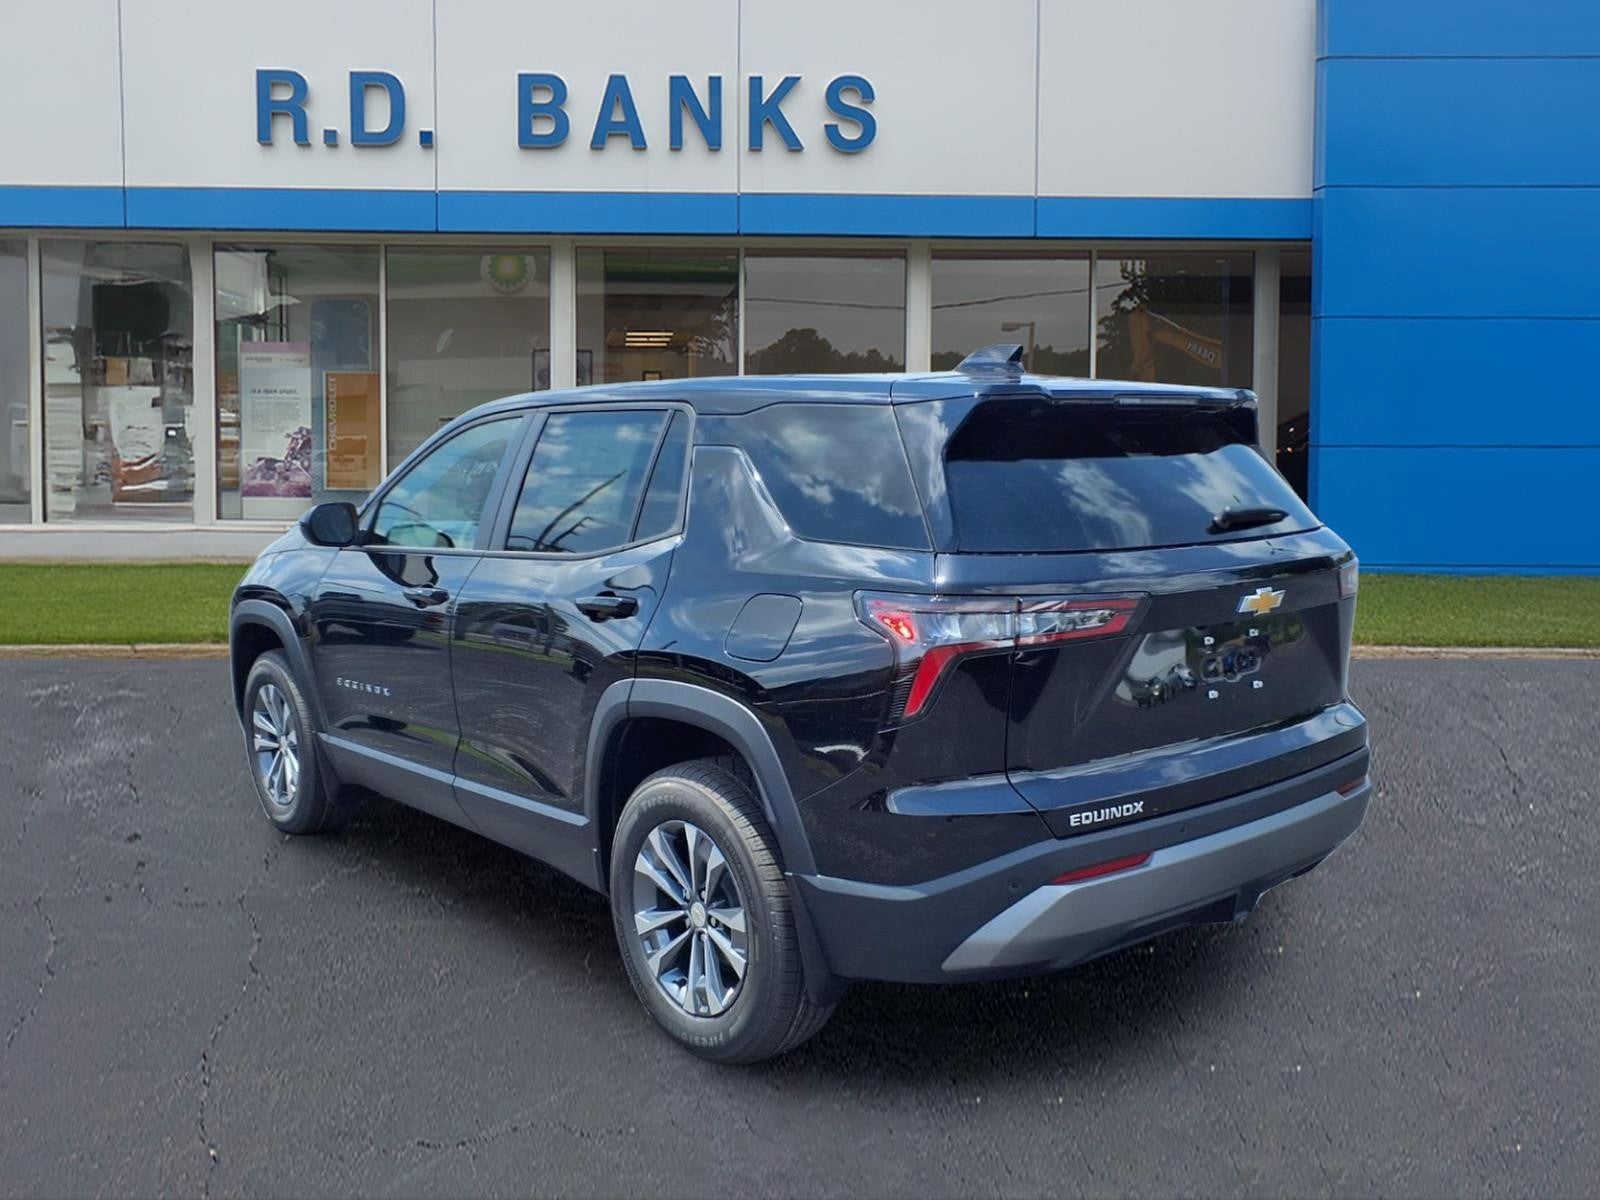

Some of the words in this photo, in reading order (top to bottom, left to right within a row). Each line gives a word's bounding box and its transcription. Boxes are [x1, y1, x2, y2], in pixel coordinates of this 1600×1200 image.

[256, 69, 434, 147] R.D.
[517, 73, 877, 153] BANKS
[328, 376, 337, 451] CHEVROLET
[1069, 801, 1144, 827] EQUINOX
